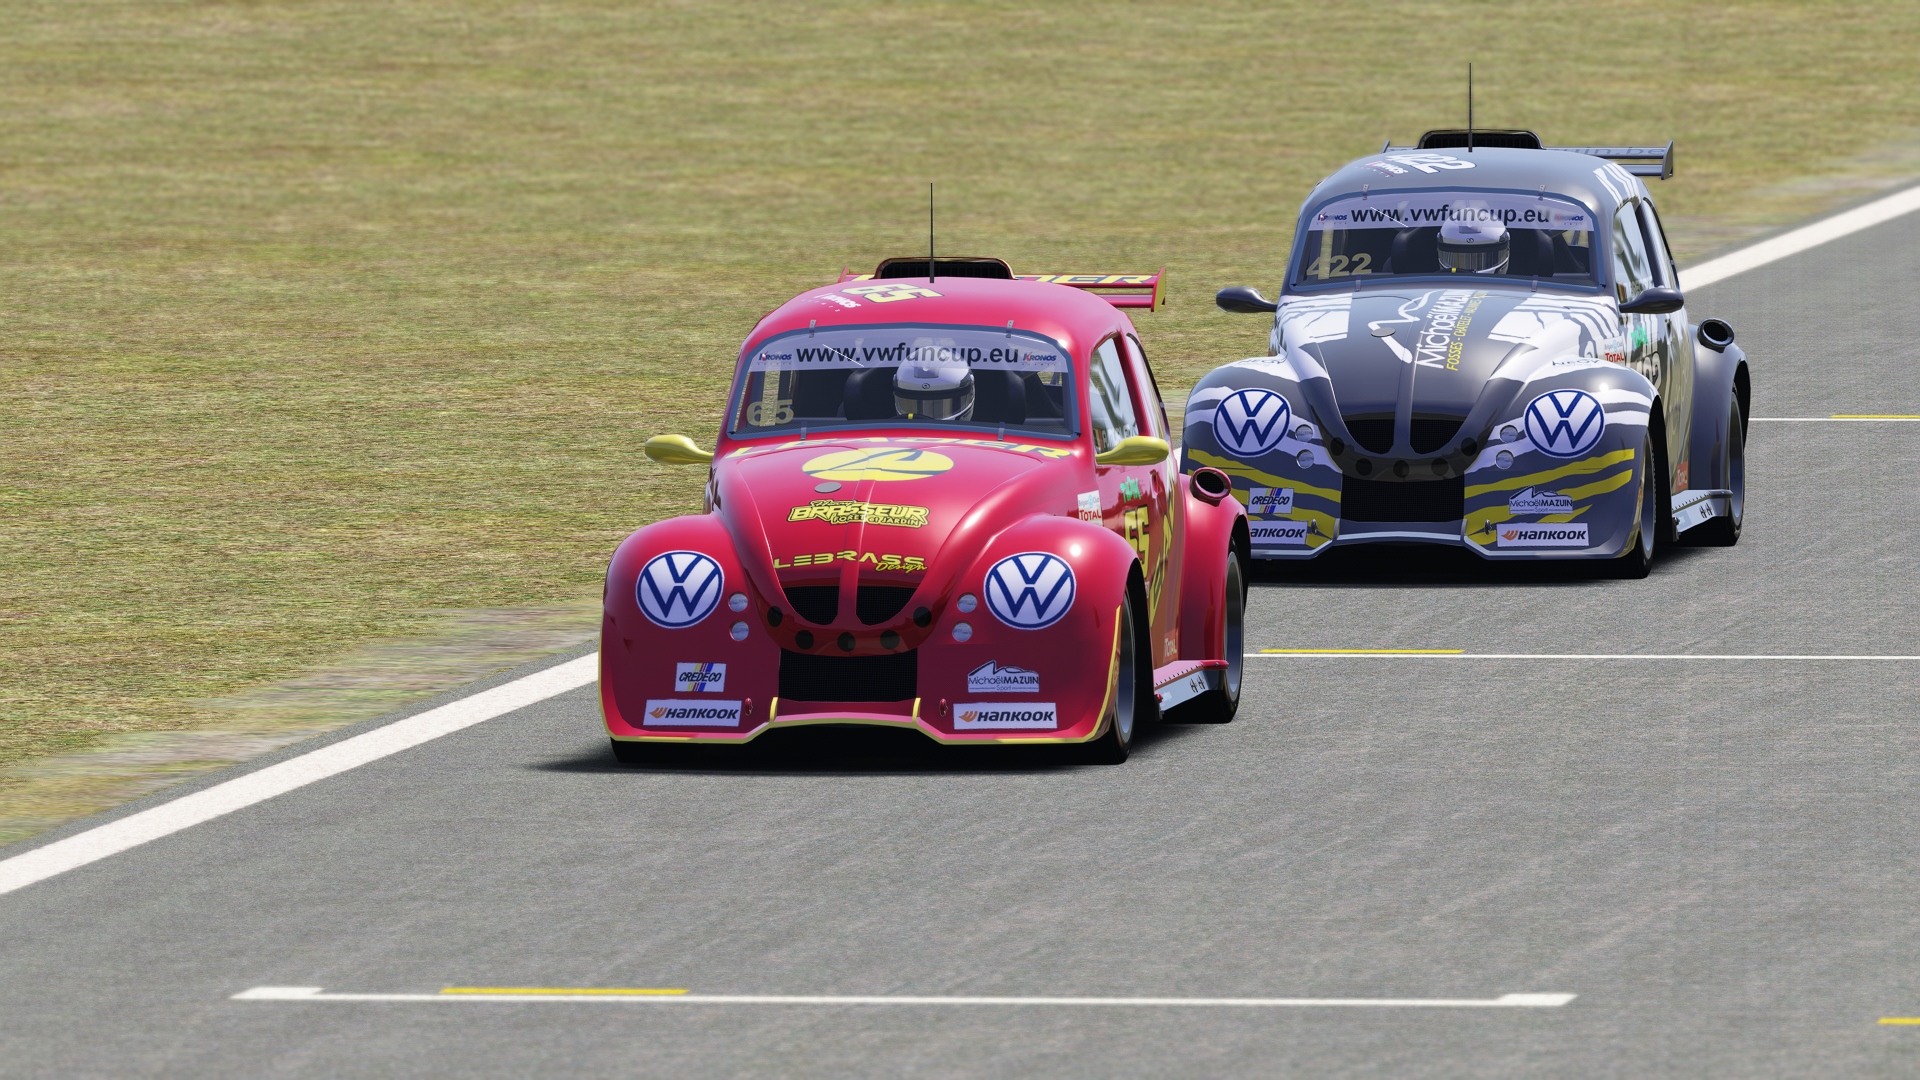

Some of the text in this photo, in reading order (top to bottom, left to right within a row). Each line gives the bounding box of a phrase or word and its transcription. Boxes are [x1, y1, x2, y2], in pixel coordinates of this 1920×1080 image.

[1351, 205, 1550, 225] www.vwfuncup.eu
[1307, 253, 1372, 280] 422
[758, 351, 792, 361] KRONOS
[795, 343, 1019, 366] www.vwfuncup.eu
[1022, 352, 1057, 361] KRONOS
[1446, 341, 1463, 371] FOSSES
[1605, 353, 1624, 362] TOTAL
[746, 399, 795, 426] 65
[1252, 496, 1290, 505] CREDECO
[790, 503, 927, 523] BRASSEUR
[1079, 509, 1102, 521] TOTAL
[881, 517, 920, 527] JARDIN
[773, 550, 925, 569] LEBRASS
[875, 561, 928, 573] Design
[679, 671, 722, 682] CREDECO
